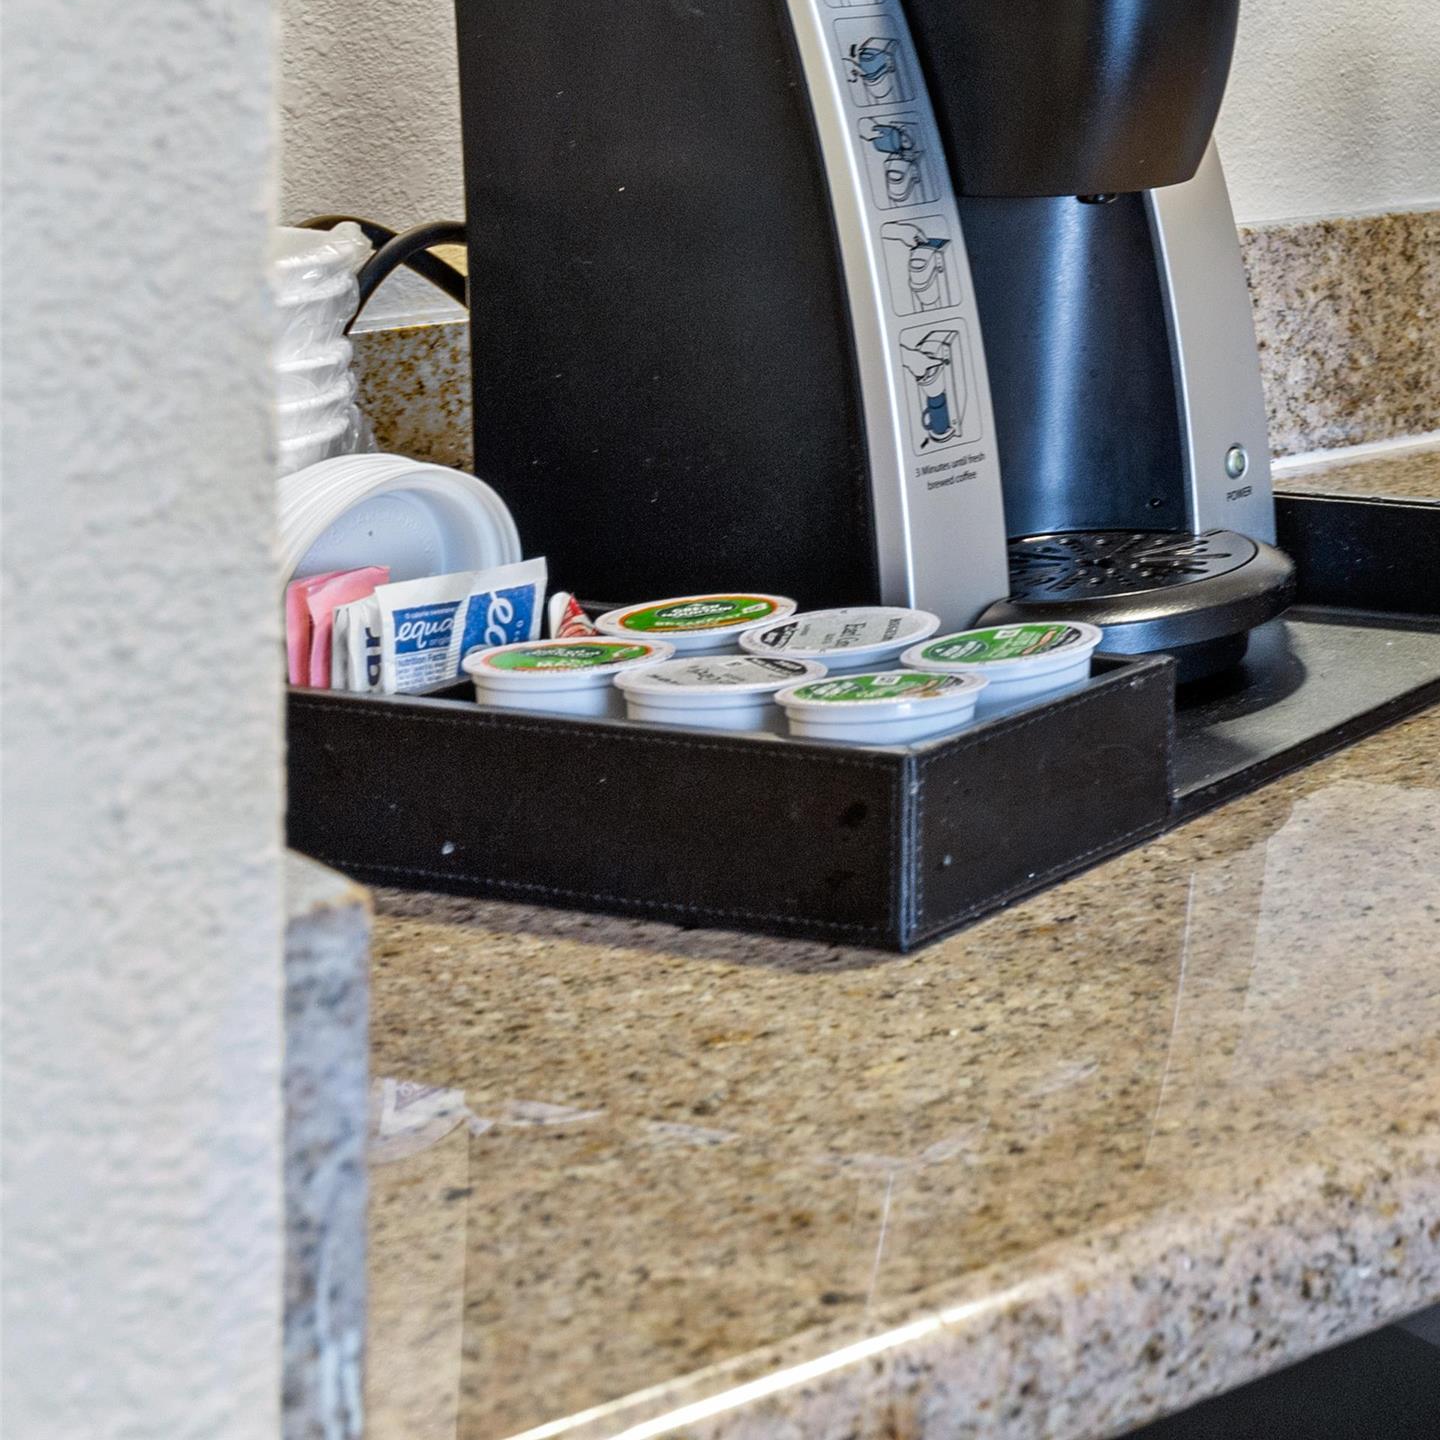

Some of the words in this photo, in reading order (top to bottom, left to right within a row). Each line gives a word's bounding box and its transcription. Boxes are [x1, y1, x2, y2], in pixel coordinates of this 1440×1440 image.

[921, 463, 951, 475] Minutes
[928, 476, 954, 490] brewed
[955, 470, 977, 483] coffee
[1226, 485, 1252, 502] POWER
